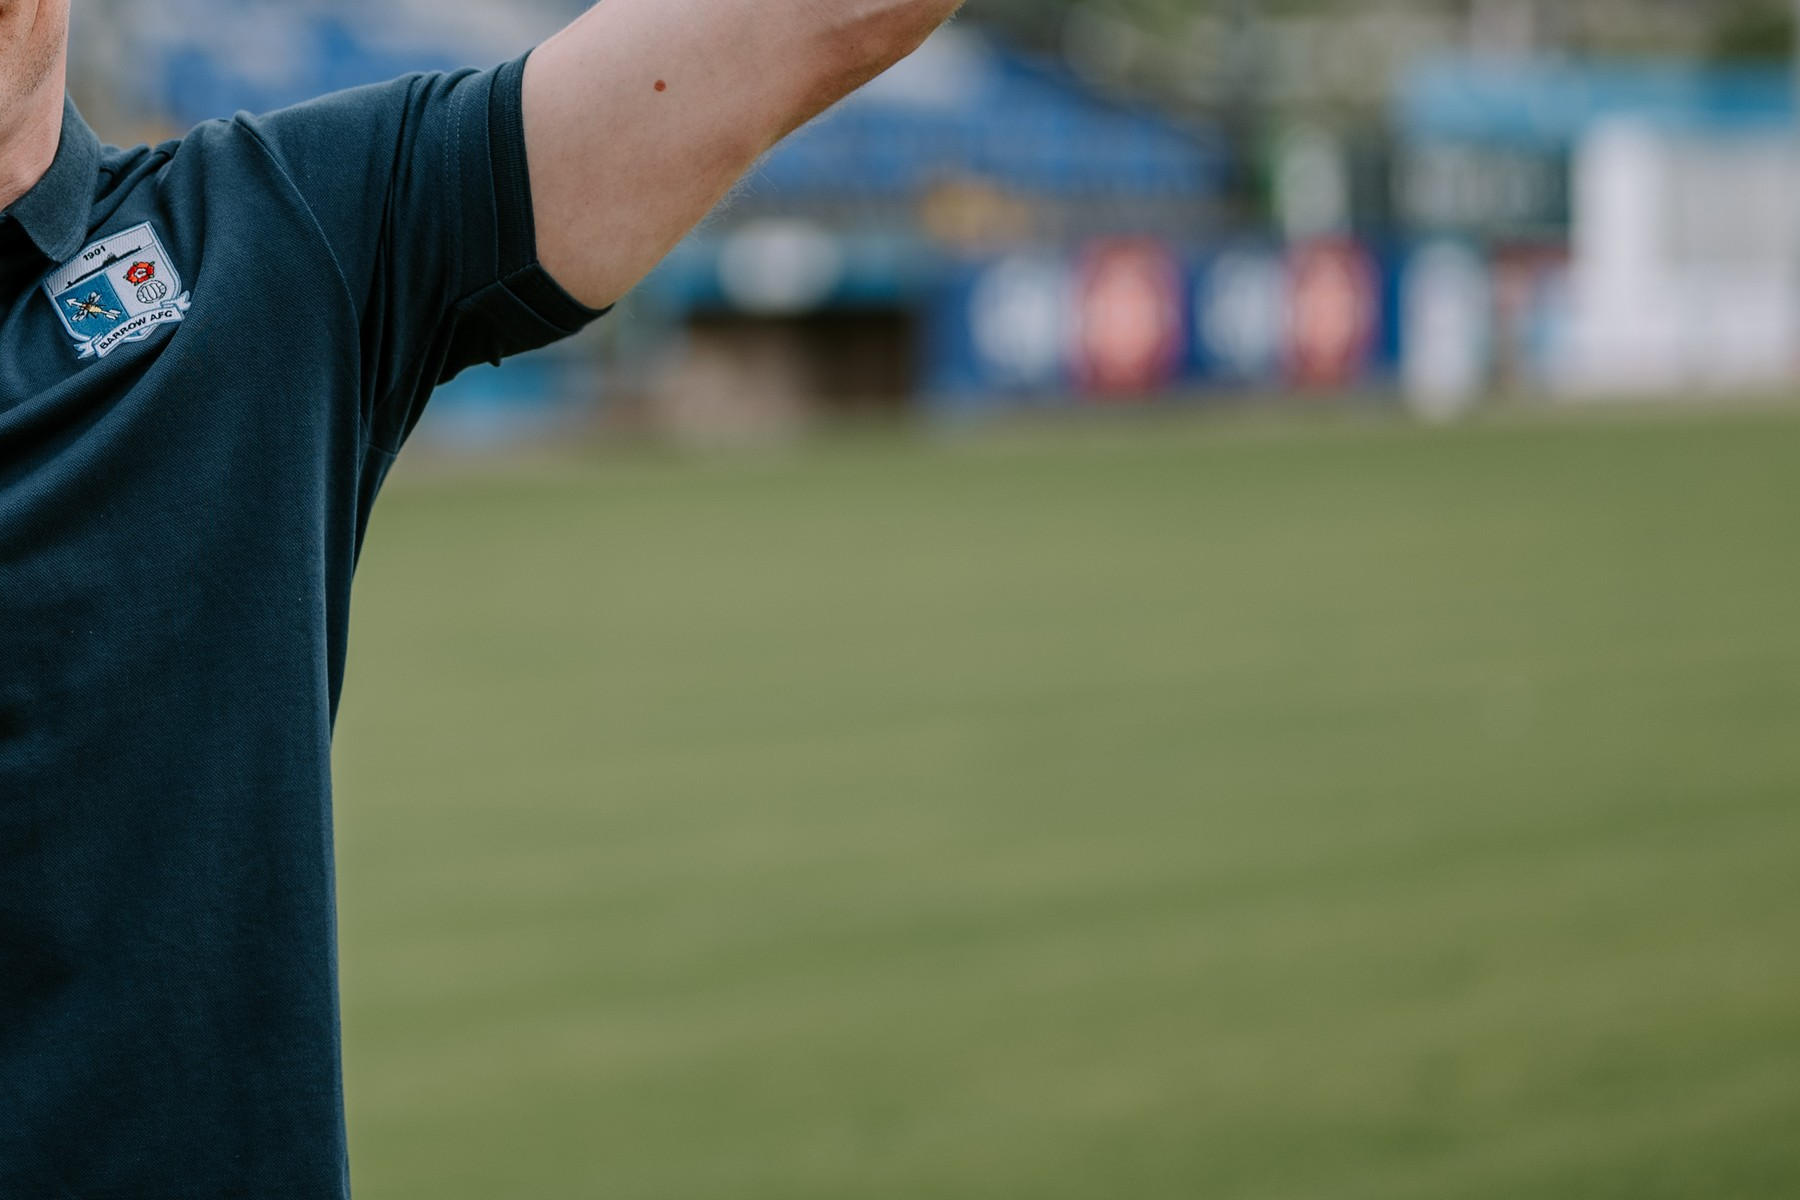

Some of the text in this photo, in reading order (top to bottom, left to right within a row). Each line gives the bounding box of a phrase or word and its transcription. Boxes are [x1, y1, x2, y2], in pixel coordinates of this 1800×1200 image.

[82, 245, 107, 261] 1901
[99, 310, 173, 350] BARROW AFC
